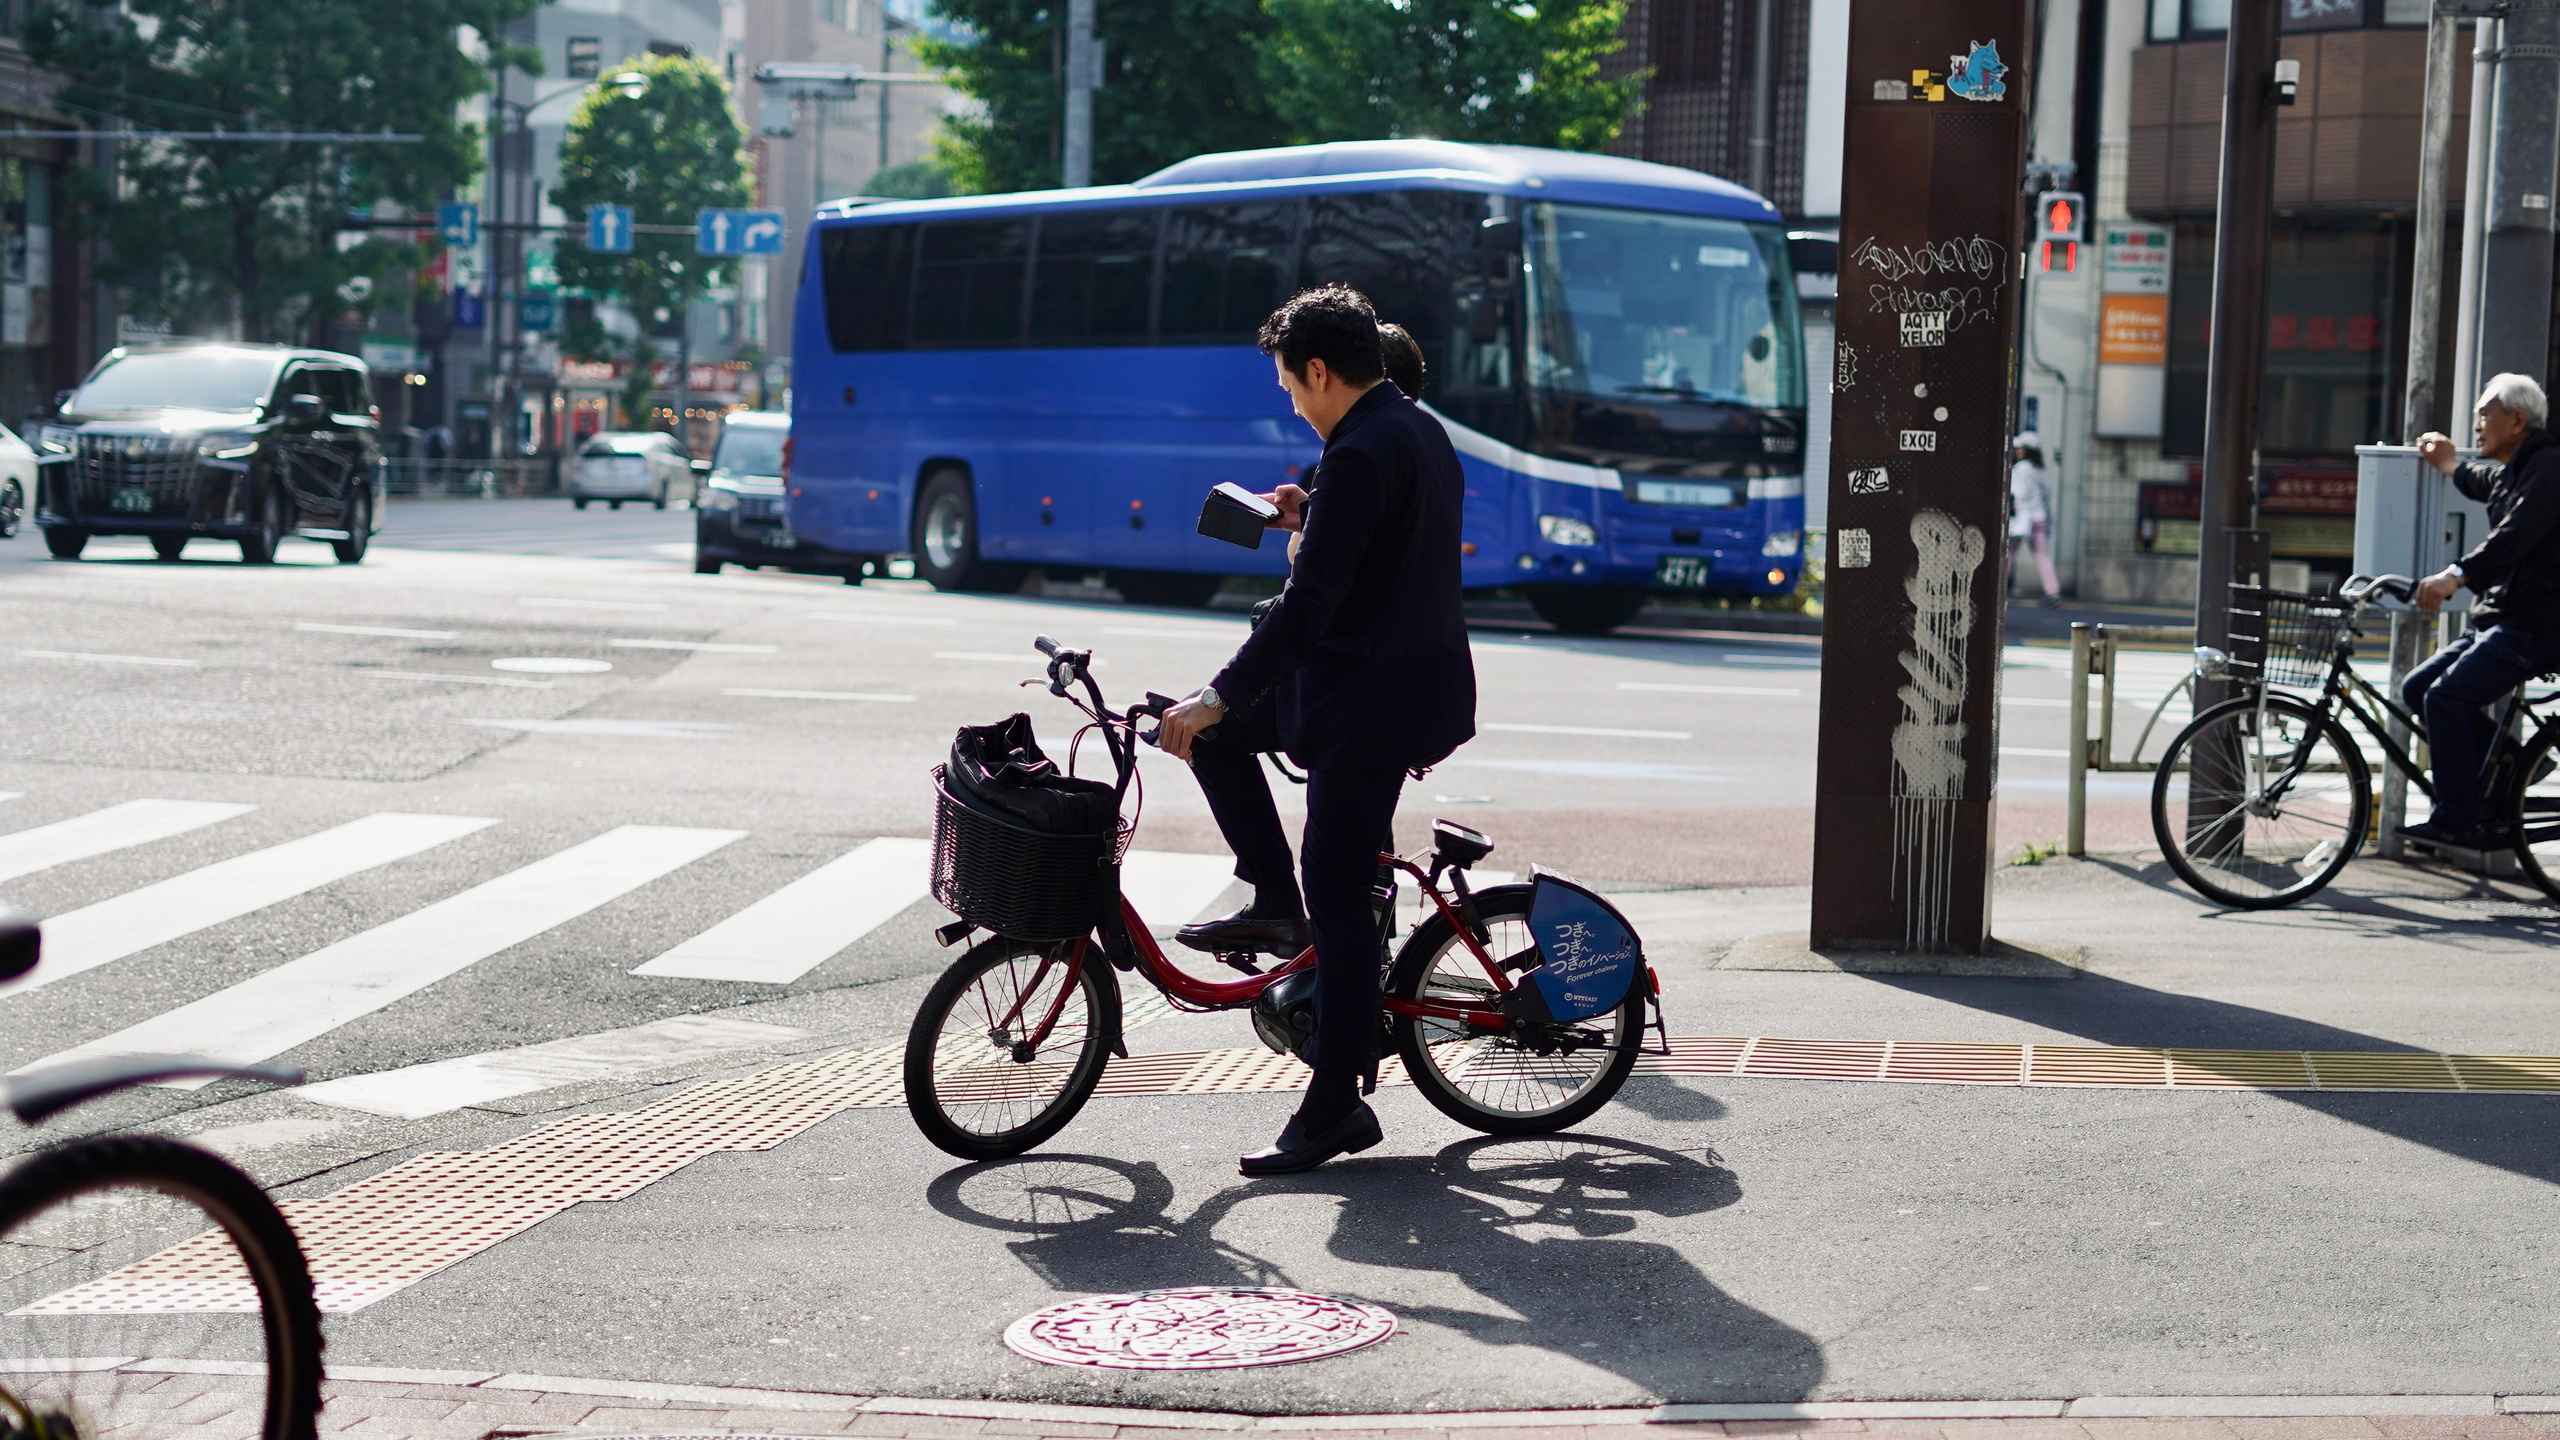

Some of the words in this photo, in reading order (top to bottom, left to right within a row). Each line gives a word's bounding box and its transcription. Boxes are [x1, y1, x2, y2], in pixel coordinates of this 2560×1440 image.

[1904, 313, 1940, 329] AQTY
[1901, 330, 1944, 346] XELOR
[1566, 970, 1594, 984] Forever
[1595, 964, 1618, 974] challenge
